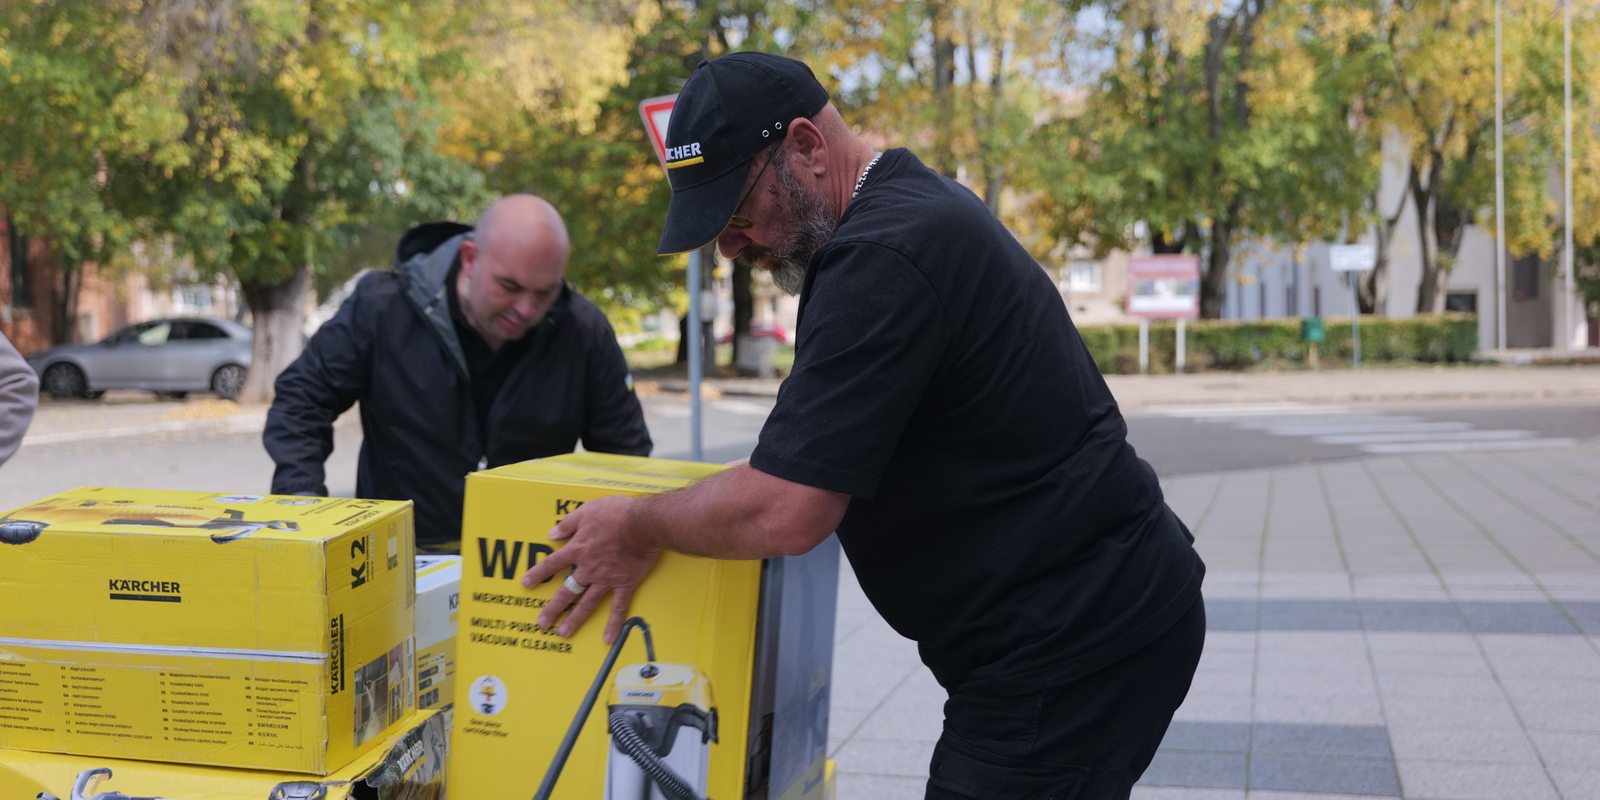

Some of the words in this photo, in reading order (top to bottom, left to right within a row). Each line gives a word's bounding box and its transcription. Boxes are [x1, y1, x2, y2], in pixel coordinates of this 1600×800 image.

[351, 536, 366, 559] 2
[351, 561, 366, 589] K
[109, 579, 181, 593] KÄRCHER
[472, 592, 549, 609] MEHRZWECK
[471, 617, 560, 637] MULTI-PURPOS
[470, 632, 518, 646] VACUUM
[521, 637, 573, 653] CLEANER
[331, 616, 339, 694] KÄRCHER
